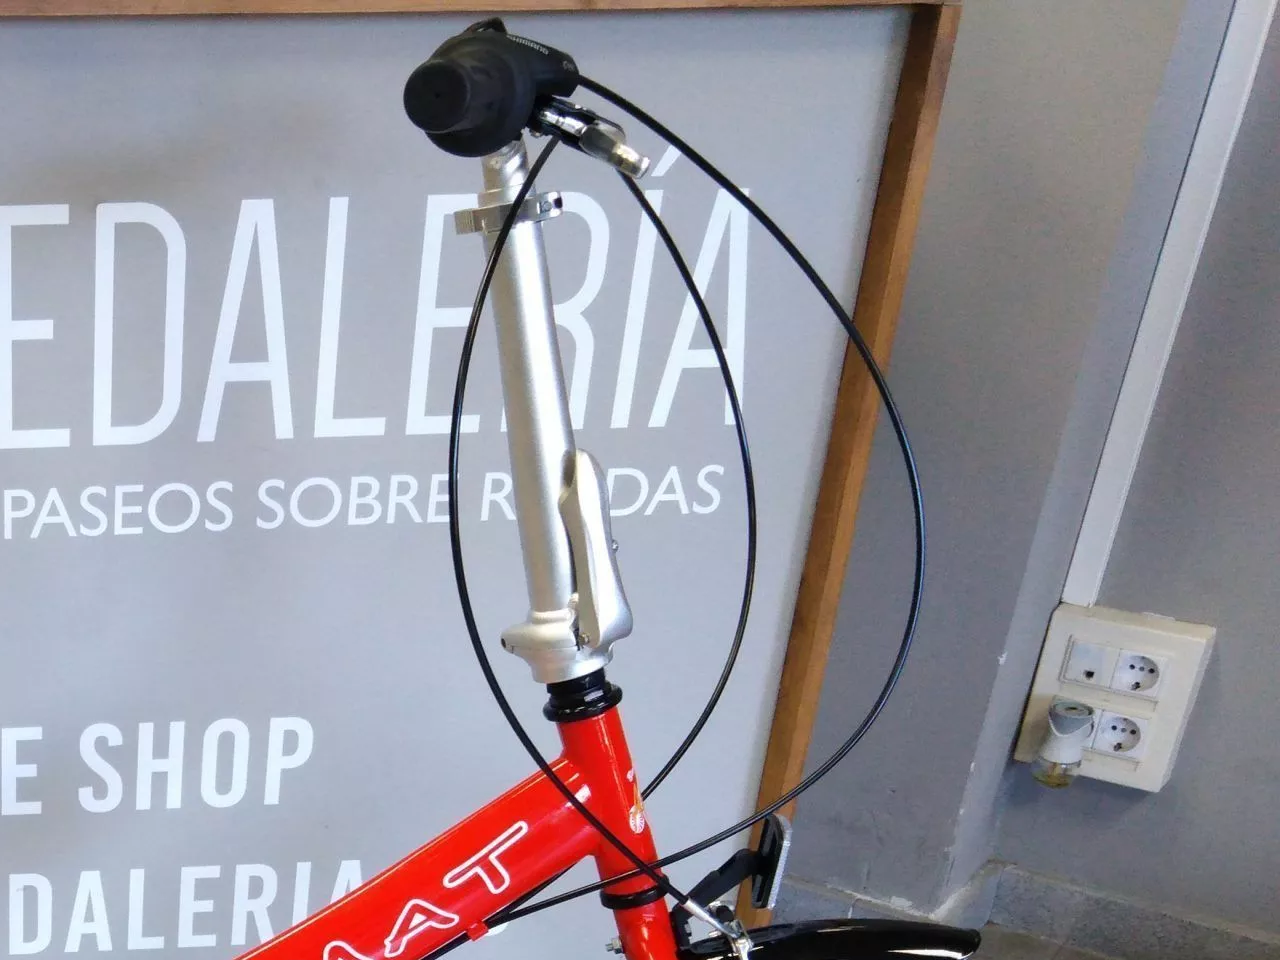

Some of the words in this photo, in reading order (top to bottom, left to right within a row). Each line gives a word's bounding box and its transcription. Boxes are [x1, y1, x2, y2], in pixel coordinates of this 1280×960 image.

[3, 481, 234, 540] PASEOS
[256, 473, 460, 531] SOBRE
[480, 464, 725, 522] RDAS
[78, 716, 314, 813] SHOP
